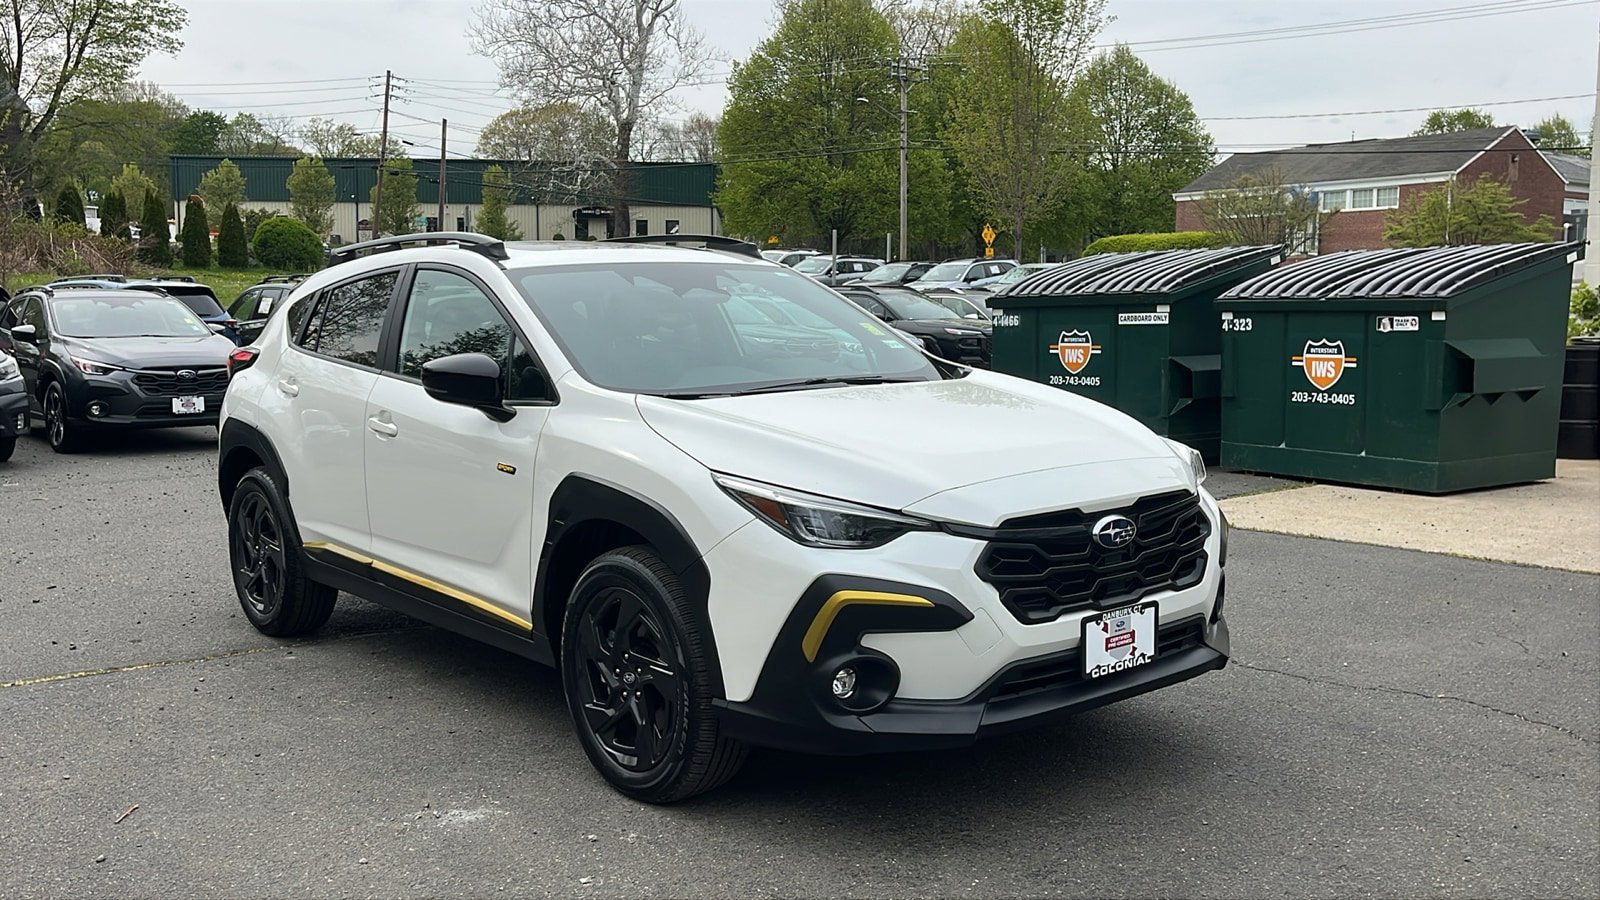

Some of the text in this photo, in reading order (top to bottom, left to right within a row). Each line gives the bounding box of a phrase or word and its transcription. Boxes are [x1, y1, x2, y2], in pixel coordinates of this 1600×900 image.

[1120, 314, 1168, 322] CARDBOARD ONLY
[1065, 348, 1085, 364] IWS
[1311, 360, 1336, 378] IWS
[1050, 375, 1101, 386] 203-743-0405
[1291, 391, 1356, 405] 203-743-0405
[1102, 604, 1143, 621] DANBURY CT
[1109, 633, 1131, 643] CERTIFIED
[1091, 655, 1151, 678] COLONIAL
